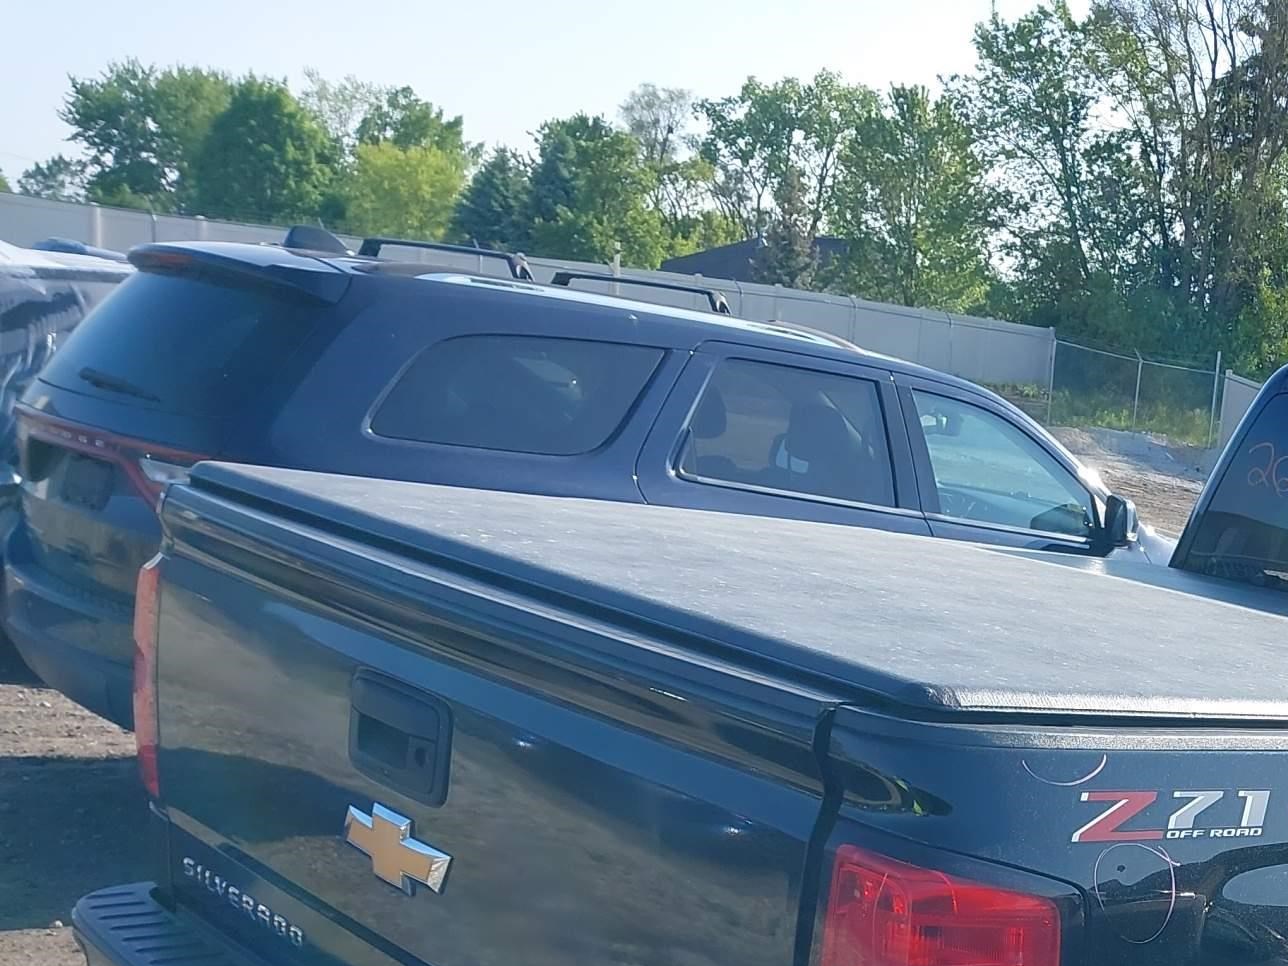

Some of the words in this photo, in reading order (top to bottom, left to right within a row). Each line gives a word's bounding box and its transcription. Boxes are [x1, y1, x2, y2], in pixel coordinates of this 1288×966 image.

[1071, 788, 1271, 842] Z71
[1165, 829, 1205, 839] OFF
[1209, 827, 1263, 838] ROAD
[183, 857, 303, 946] SILVERADO
